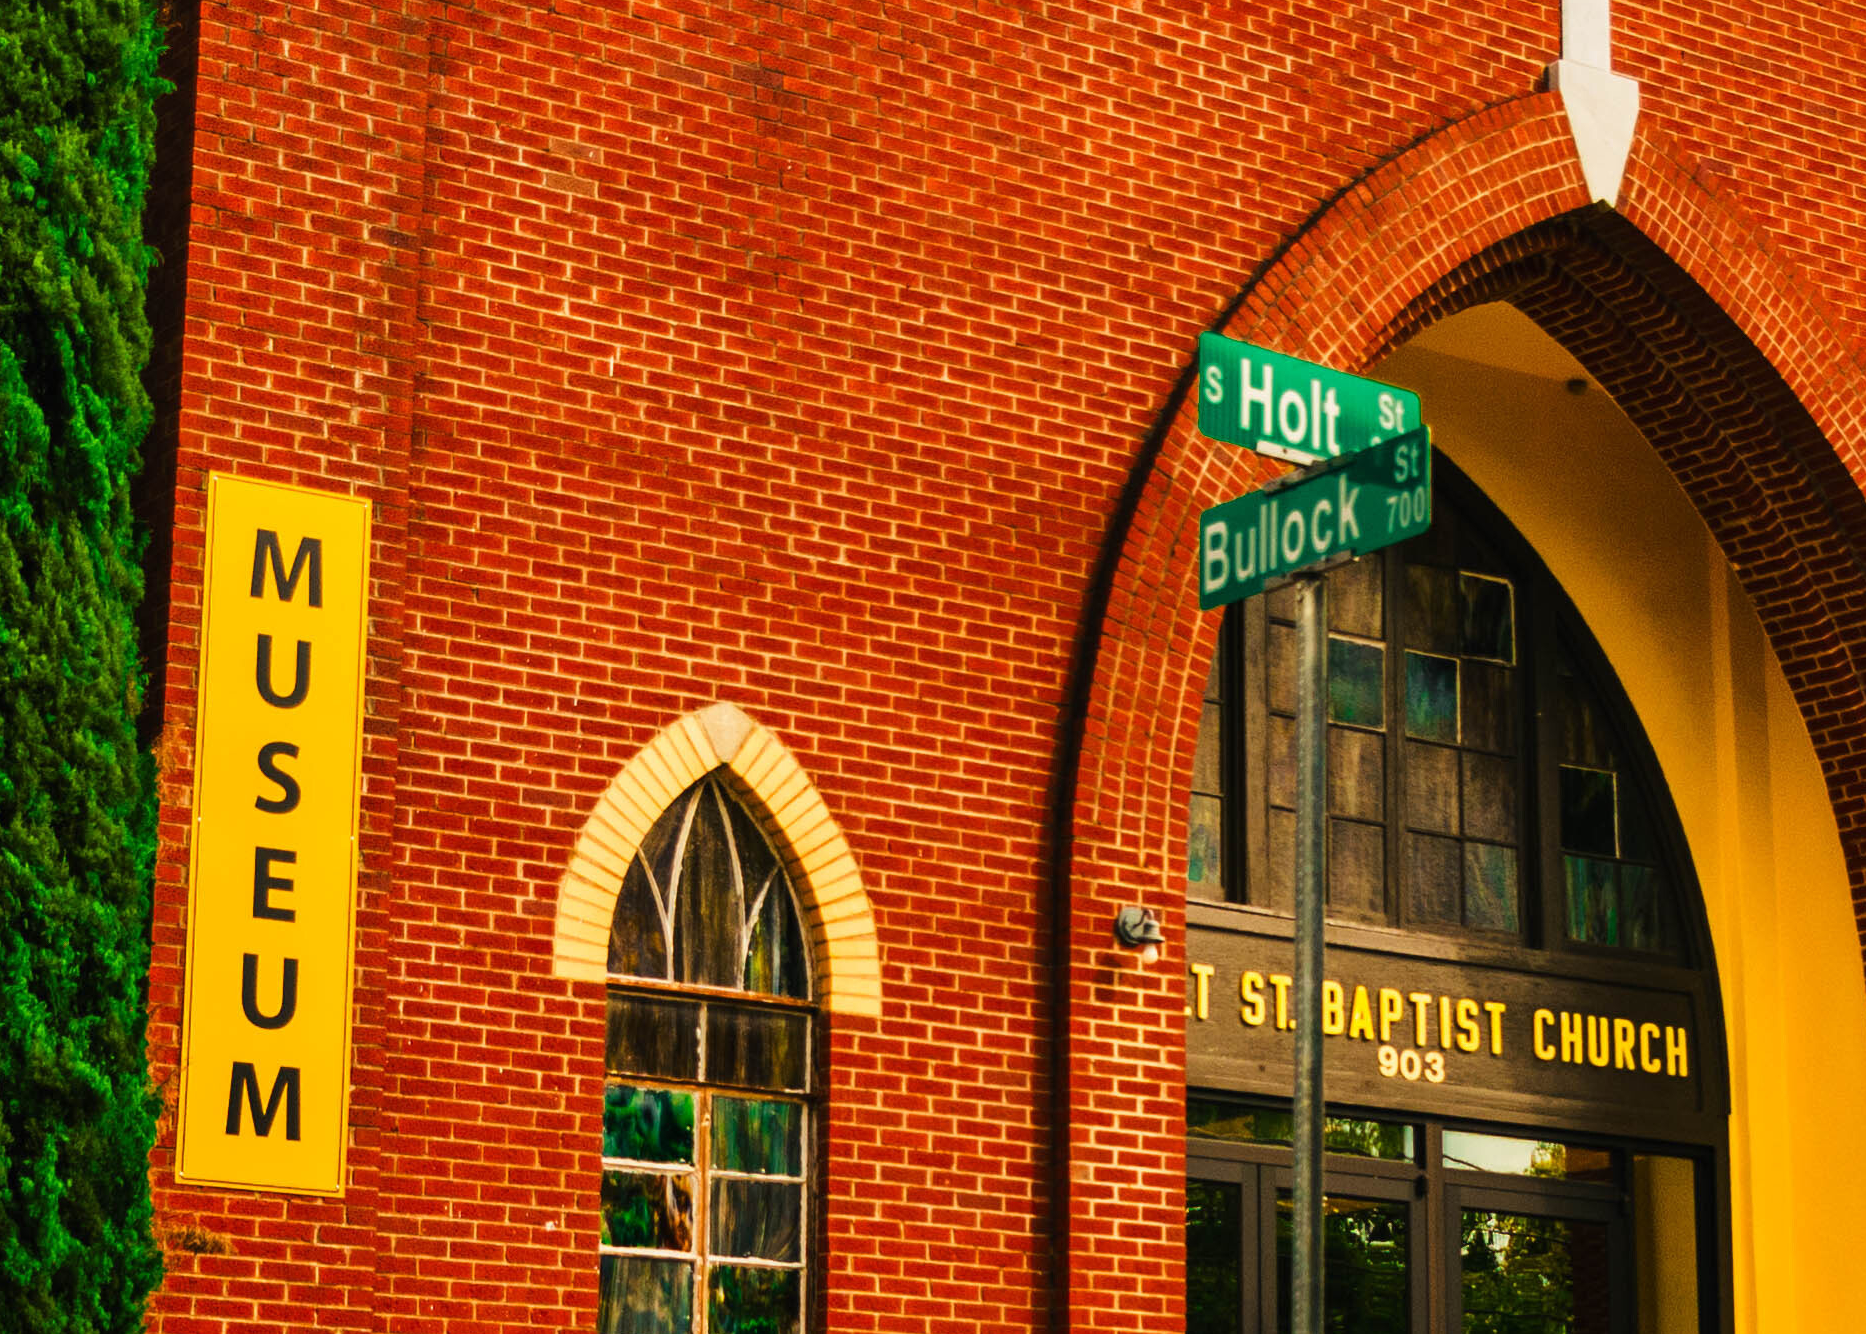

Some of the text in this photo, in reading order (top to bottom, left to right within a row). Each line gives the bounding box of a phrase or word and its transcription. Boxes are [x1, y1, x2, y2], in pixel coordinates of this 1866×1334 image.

[1205, 357, 1404, 456] S Holt St
[1204, 442, 1419, 594] Bullock St
[1387, 487, 1426, 533] 700
[224, 527, 323, 1142] MUSEUM
[1241, 970, 1297, 1030] ST.
[1323, 979, 1507, 1055] BAPTIST
[1533, 1008, 1689, 1078] CHURCH
[1378, 1045, 1445, 1083] 903
